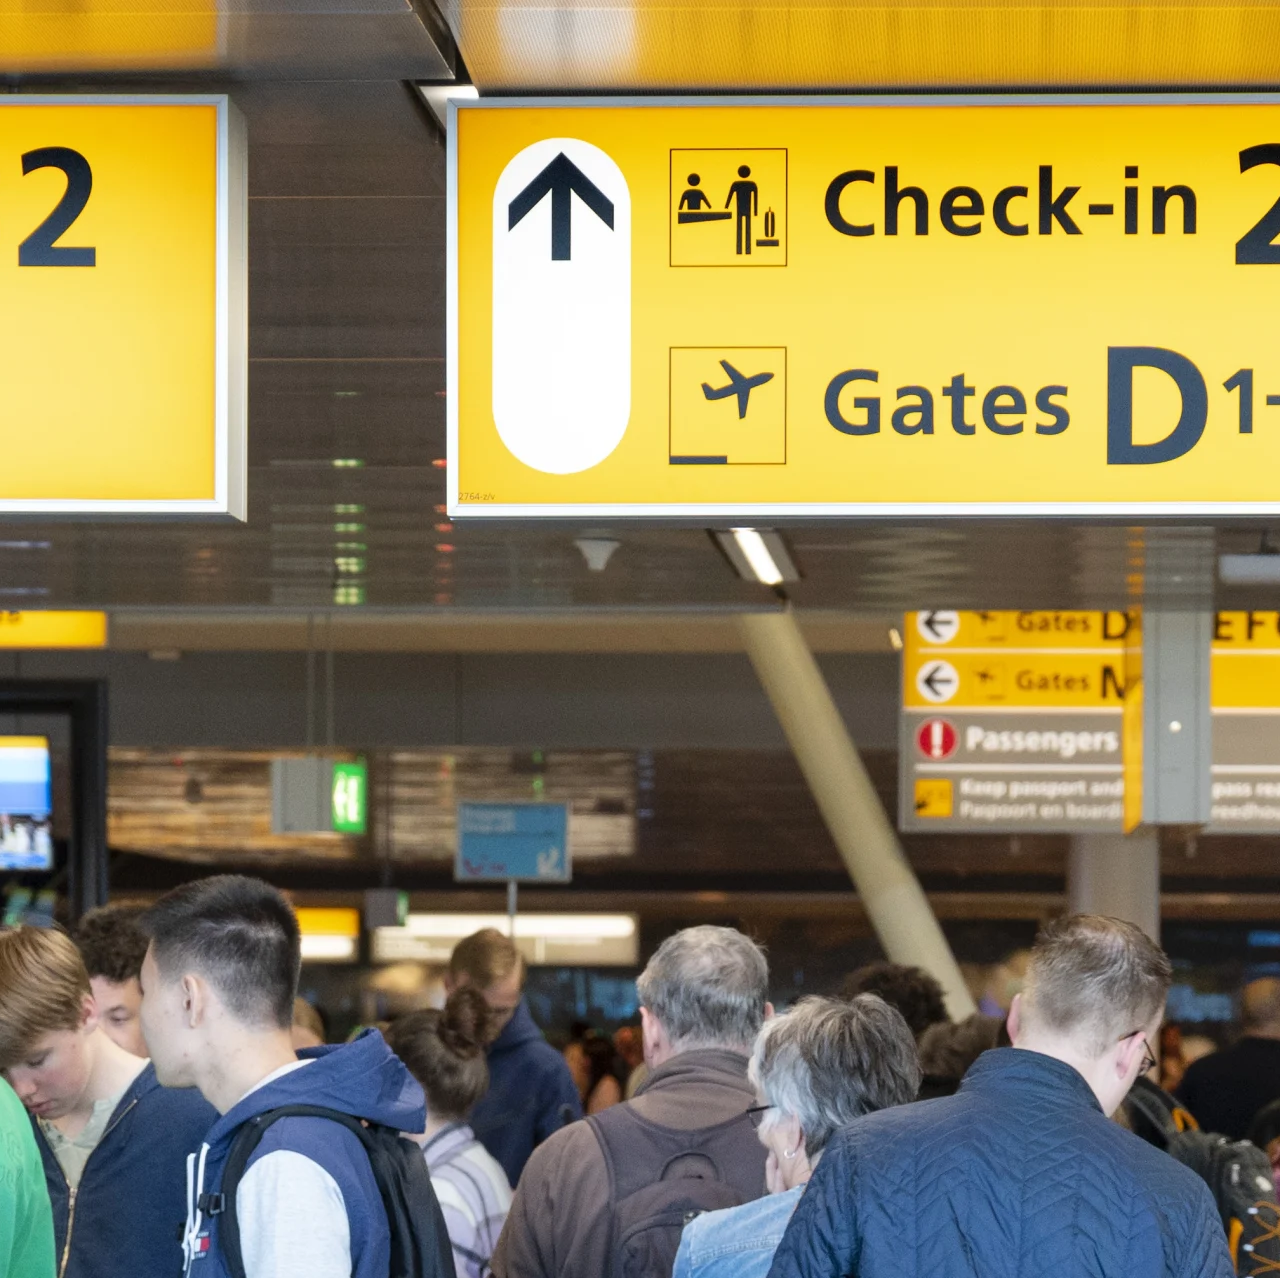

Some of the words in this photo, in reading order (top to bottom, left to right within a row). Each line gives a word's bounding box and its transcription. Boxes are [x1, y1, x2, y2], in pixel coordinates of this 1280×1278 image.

[824, 165, 1197, 236] Check-in
[824, 369, 1070, 436] Gates
[1016, 611, 1091, 633] Gates
[1016, 669, 1091, 691] Gates
[965, 726, 1119, 758] Passengers
[1010, 779, 1087, 799] passport
[1090, 778, 1124, 796] and
